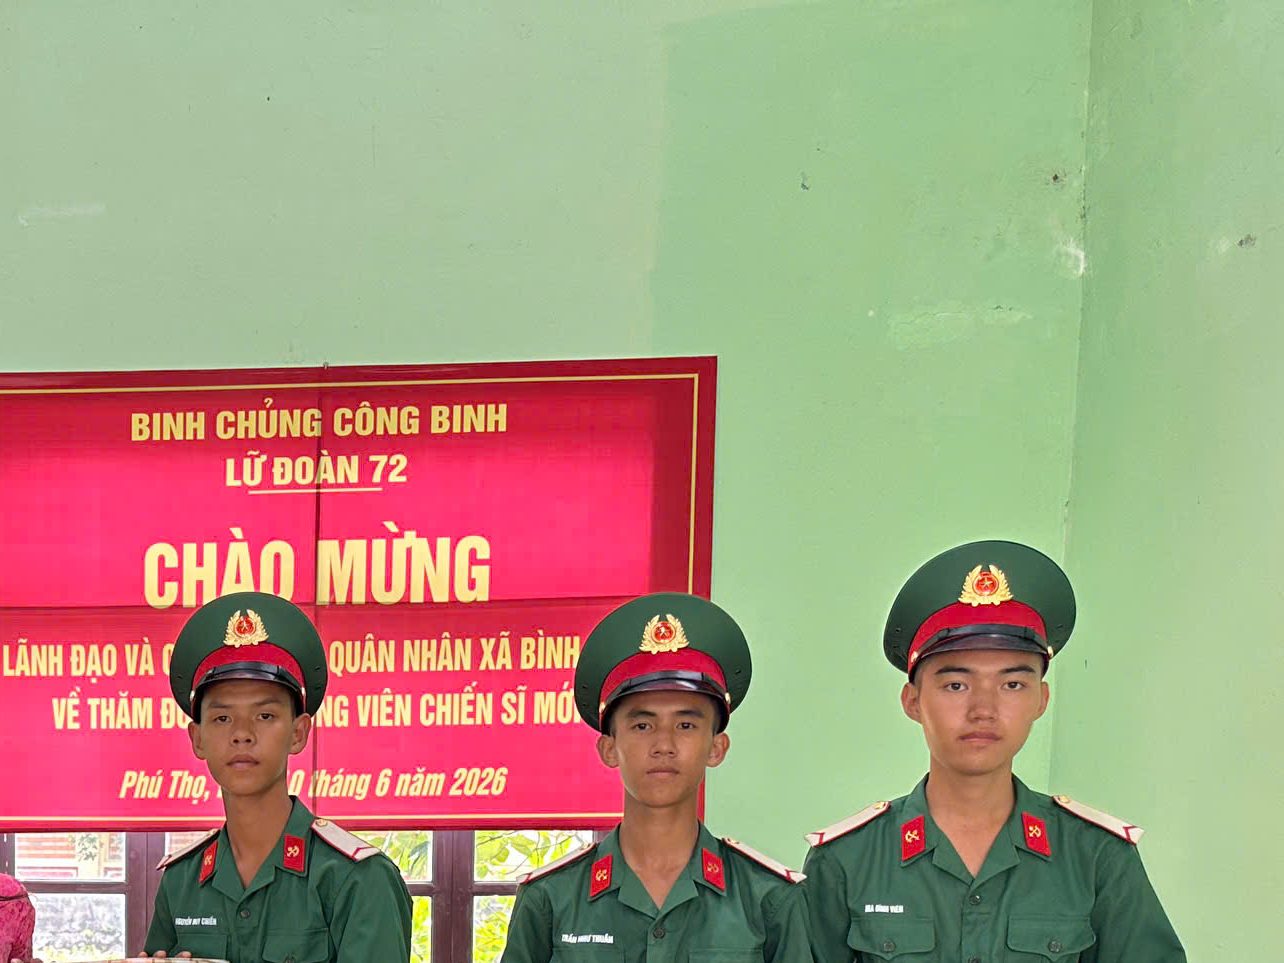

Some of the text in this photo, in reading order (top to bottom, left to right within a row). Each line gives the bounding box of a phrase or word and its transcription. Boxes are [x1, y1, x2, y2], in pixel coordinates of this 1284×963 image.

[132, 398, 507, 441] BINH CHỦNG CÔNG BINH
[226, 449, 408, 487] LỮ ĐOÀN 72
[144, 521, 491, 610] CHÀO MỪNG
[2, 638, 63, 677] LÃNH
[70, 643, 117, 684] ĐẠO
[124, 637, 155, 677] VÀ
[329, 633, 395, 677] QUÂN
[403, 632, 472, 672] NHÂN
[479, 631, 513, 671] XÃ
[520, 629, 581, 670] BÌNH
[52, 686, 81, 730] VỀ
[87, 690, 153, 730] THĂM
[356, 688, 412, 728] VIÊN
[419, 681, 493, 728] CHIẾN
[500, 685, 526, 725] SĨ
[119, 769, 164, 799] Phú
[168, 770, 210, 805] Thọ,
[307, 767, 371, 801] tháng
[375, 769, 392, 797] 6
[394, 768, 446, 797] năm
[449, 767, 509, 796] 2026
